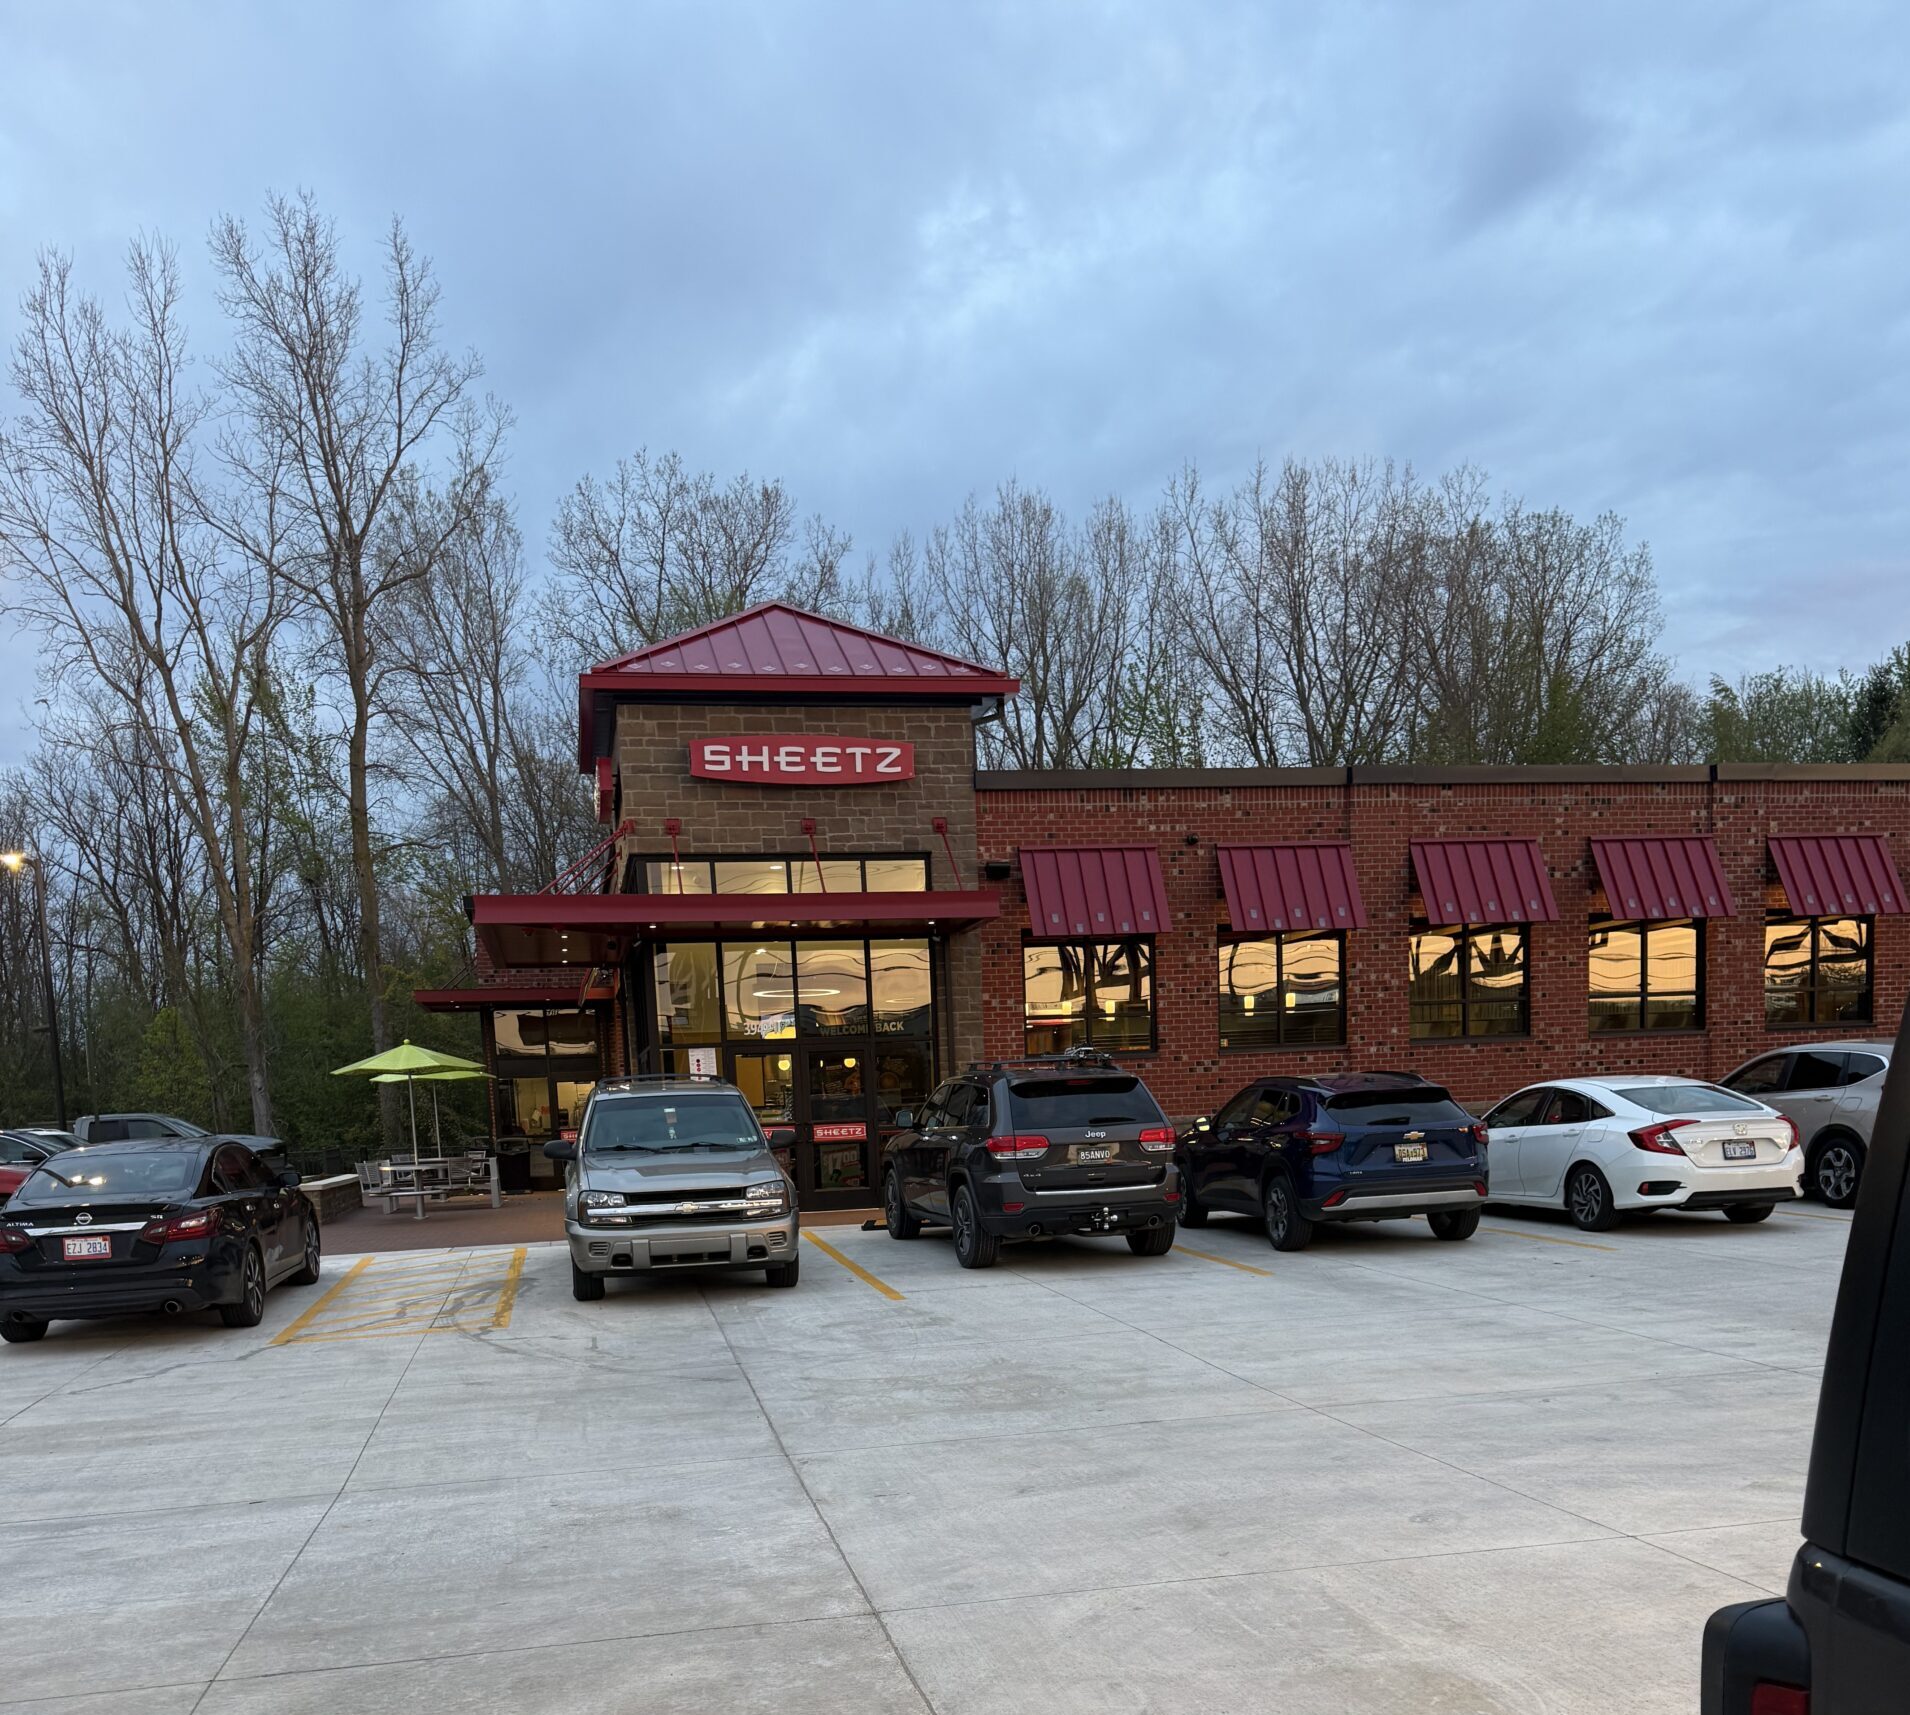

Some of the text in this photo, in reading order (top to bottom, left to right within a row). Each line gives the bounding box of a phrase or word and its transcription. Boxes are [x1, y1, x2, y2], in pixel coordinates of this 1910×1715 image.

[703, 745, 902, 773] SHEETZ
[875, 1021, 905, 1033] BACK
[816, 1127, 862, 1137] SHEETZ
[1084, 1130, 1106, 1138] Jeep
[66, 1241, 107, 1254] EZJ 2834
